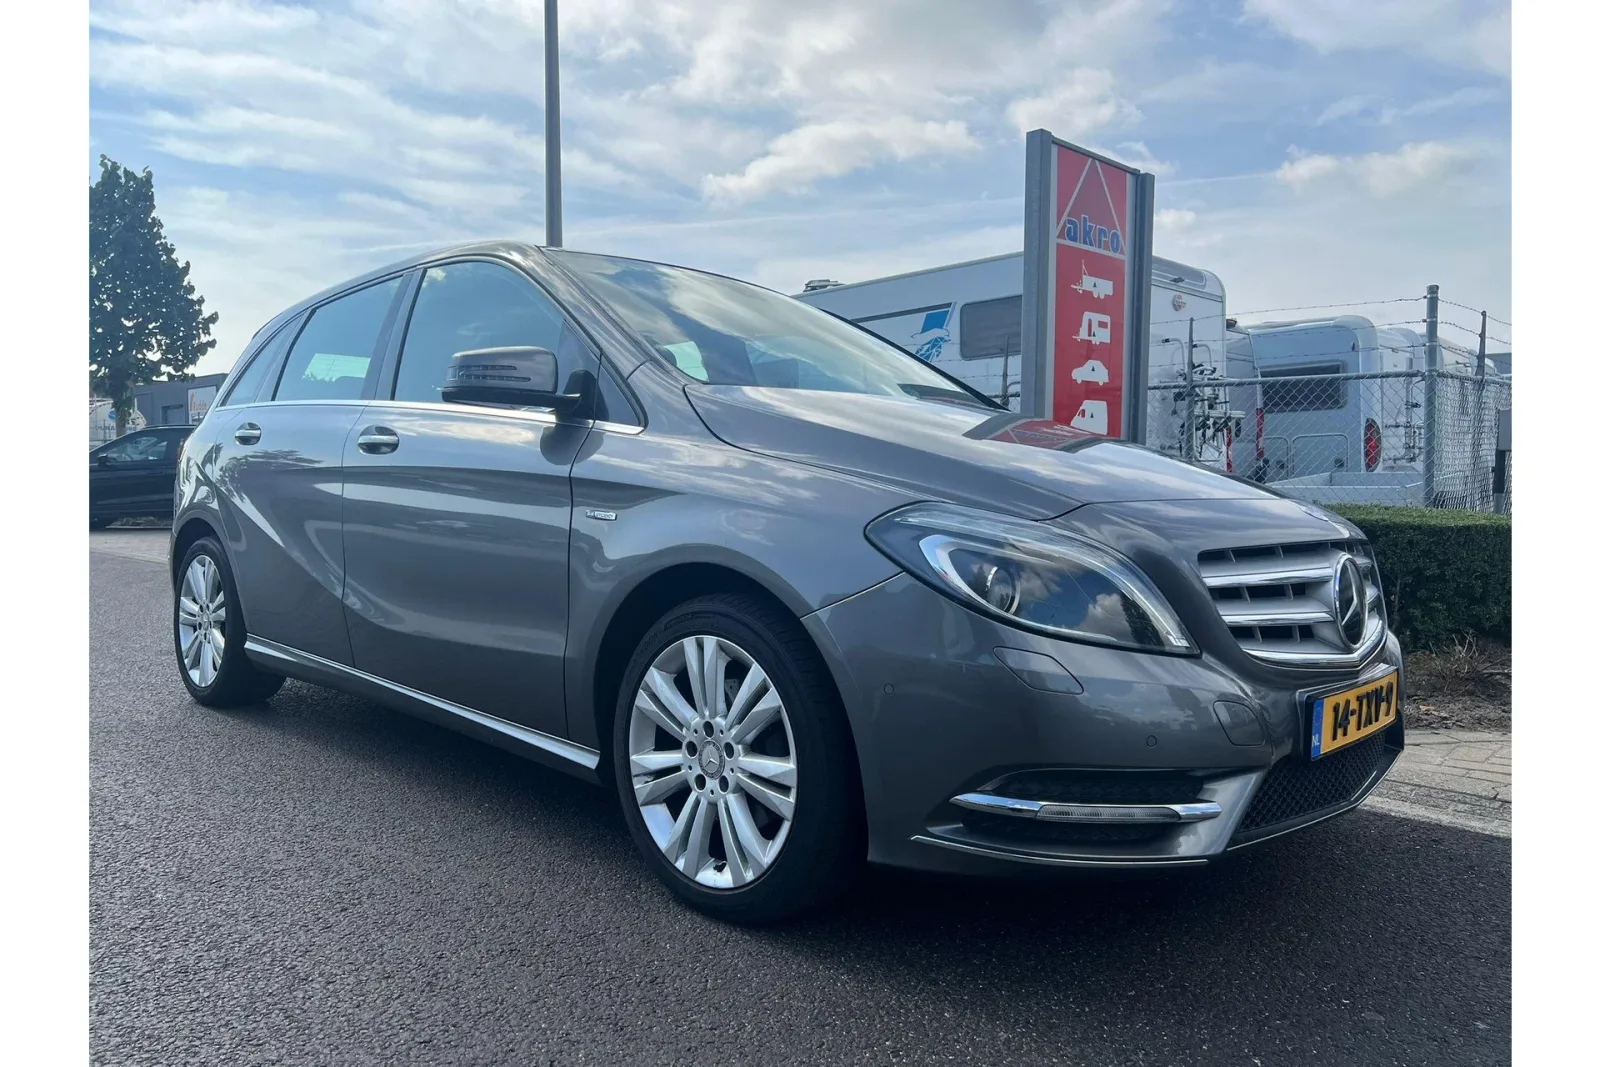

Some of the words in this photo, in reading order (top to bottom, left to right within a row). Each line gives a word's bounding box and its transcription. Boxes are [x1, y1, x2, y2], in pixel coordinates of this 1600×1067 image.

[1065, 214, 1121, 254] akro
[1331, 681, 1394, 741] 14-TXV-9
[1312, 733, 1320, 748] NL
